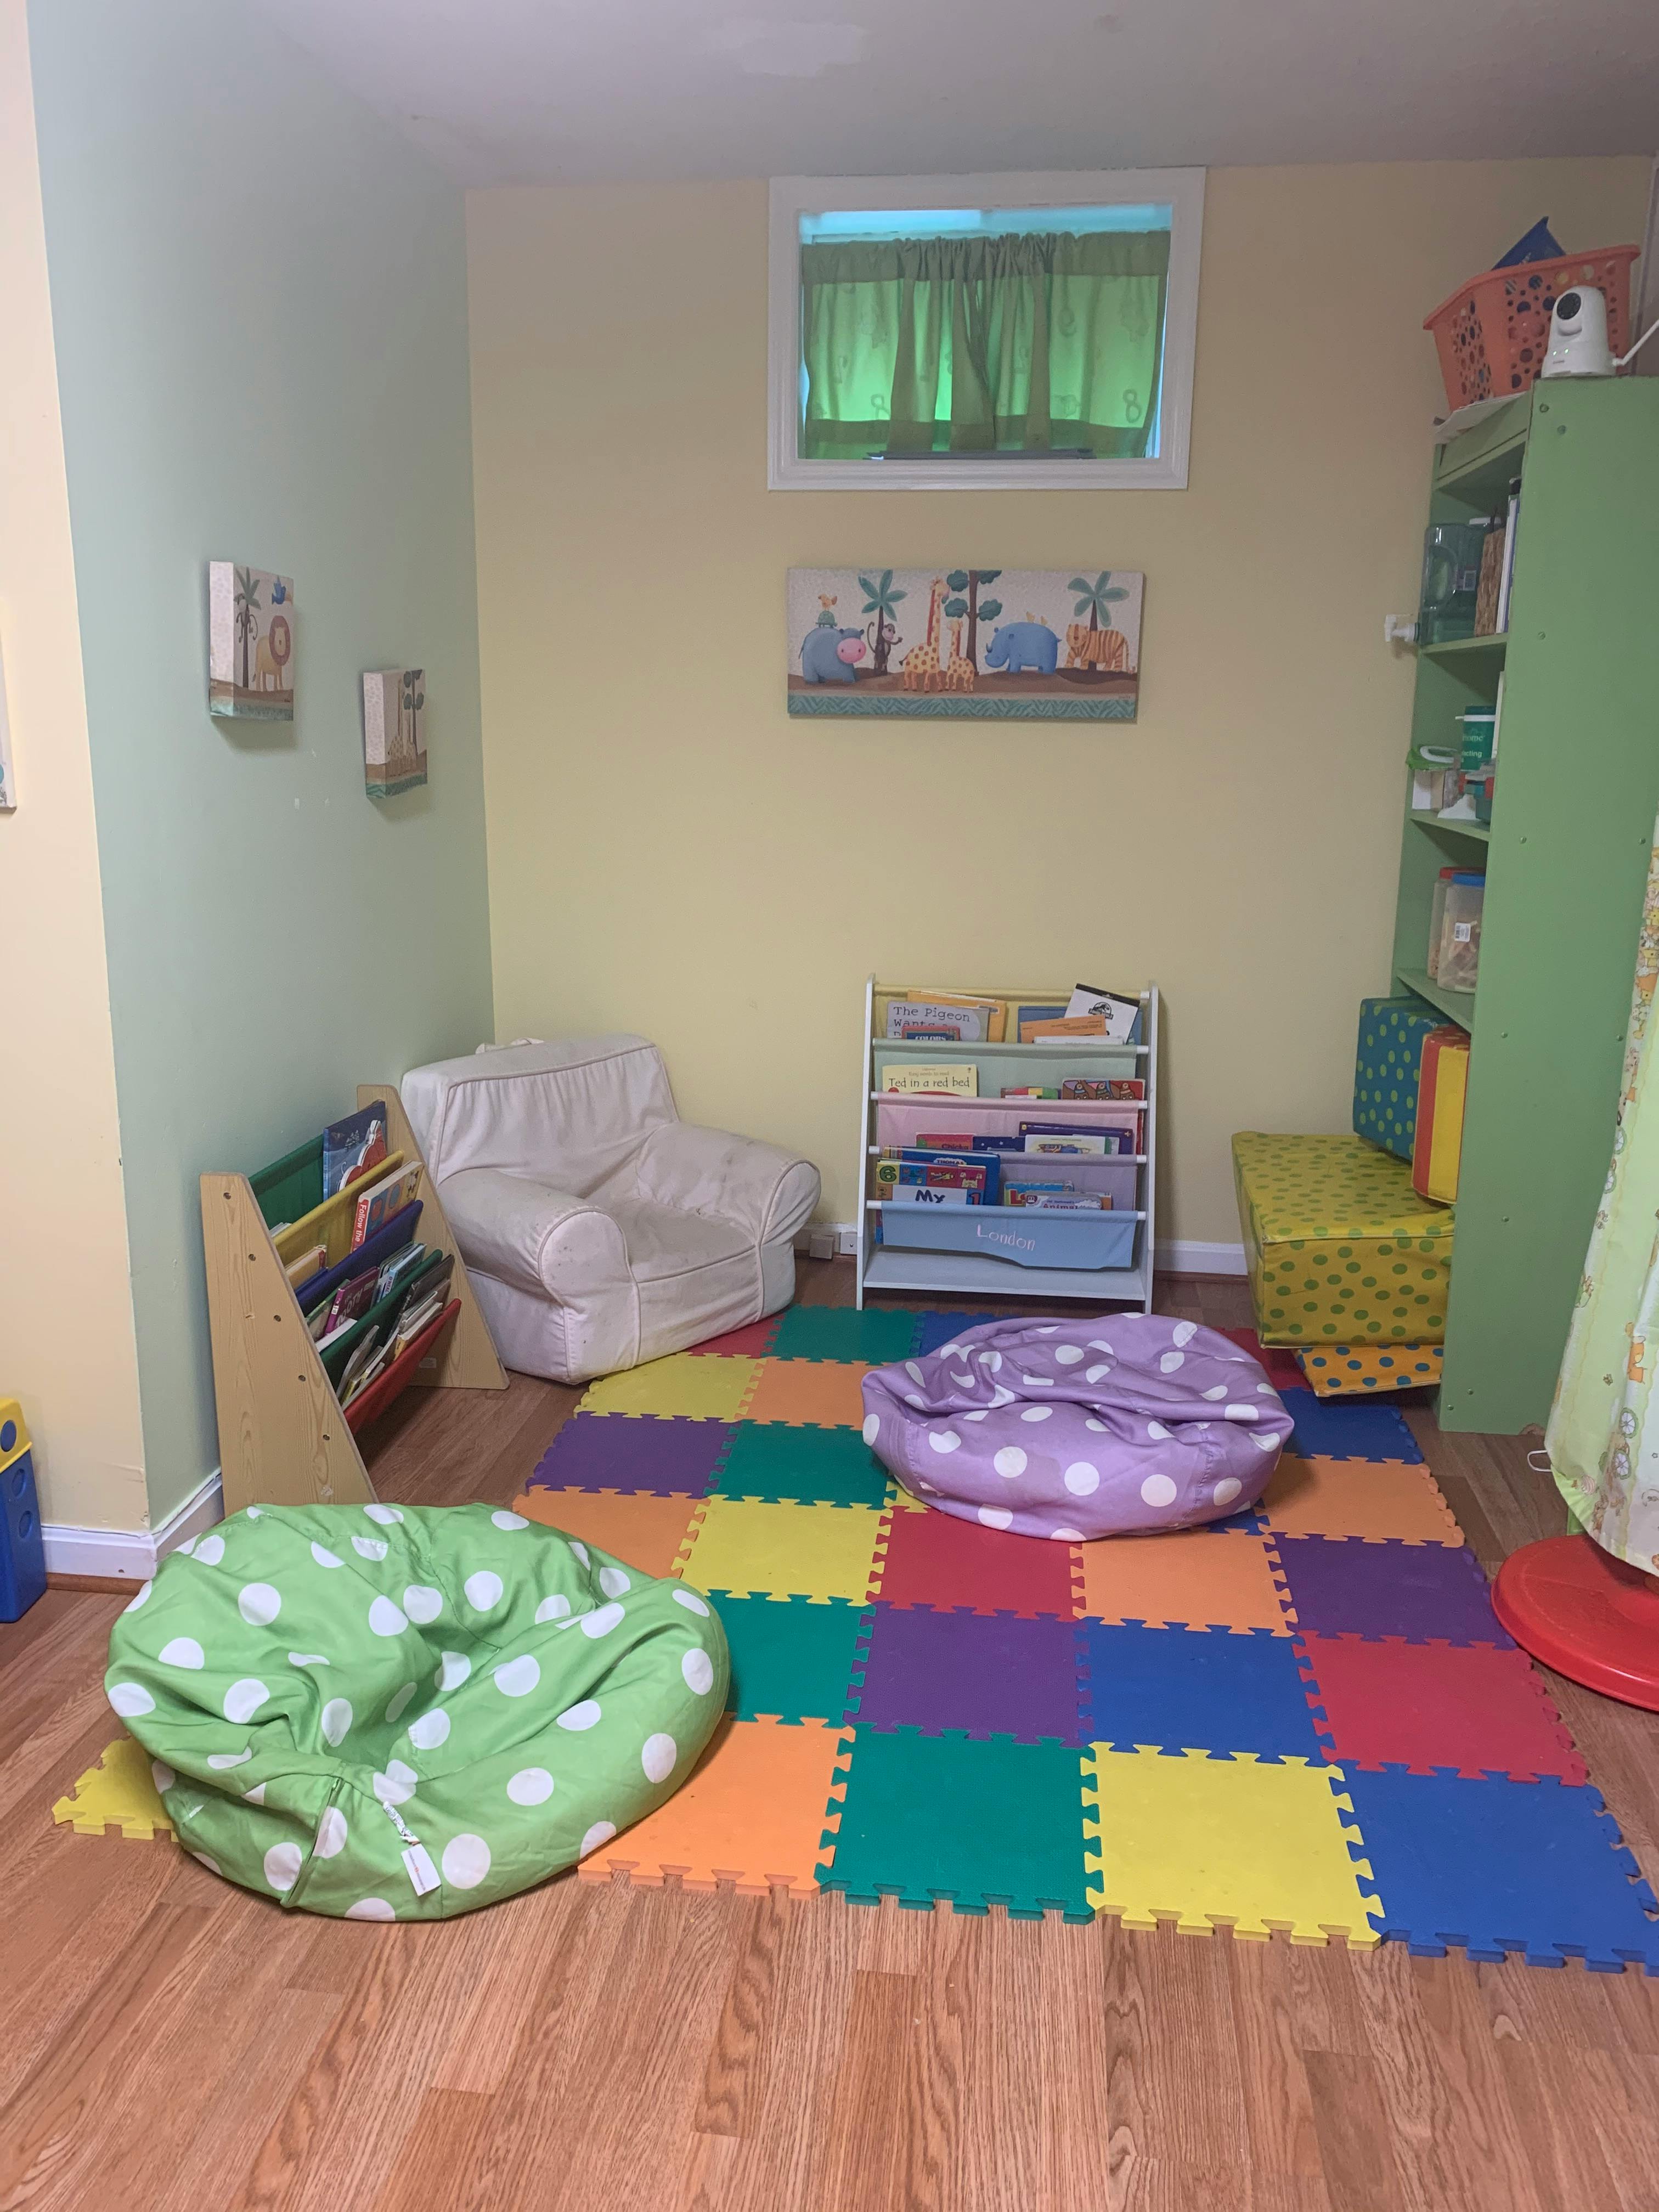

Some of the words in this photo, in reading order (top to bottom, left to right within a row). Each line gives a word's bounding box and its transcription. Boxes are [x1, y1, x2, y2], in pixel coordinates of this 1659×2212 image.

[893, 1006, 919, 1016] The
[924, 1007, 970, 1022] Pigeon
[888, 1077, 906, 1088] Ted
[910, 1079, 919, 1087] in
[933, 1077, 948, 1087] red
[952, 1076, 970, 1087] bed
[879, 1165, 897, 1182] 6
[915, 1189, 946, 1203] My
[357, 1204, 367, 1229] Follow
[354, 1230, 363, 1242] the
[975, 1224, 1036, 1251] London
